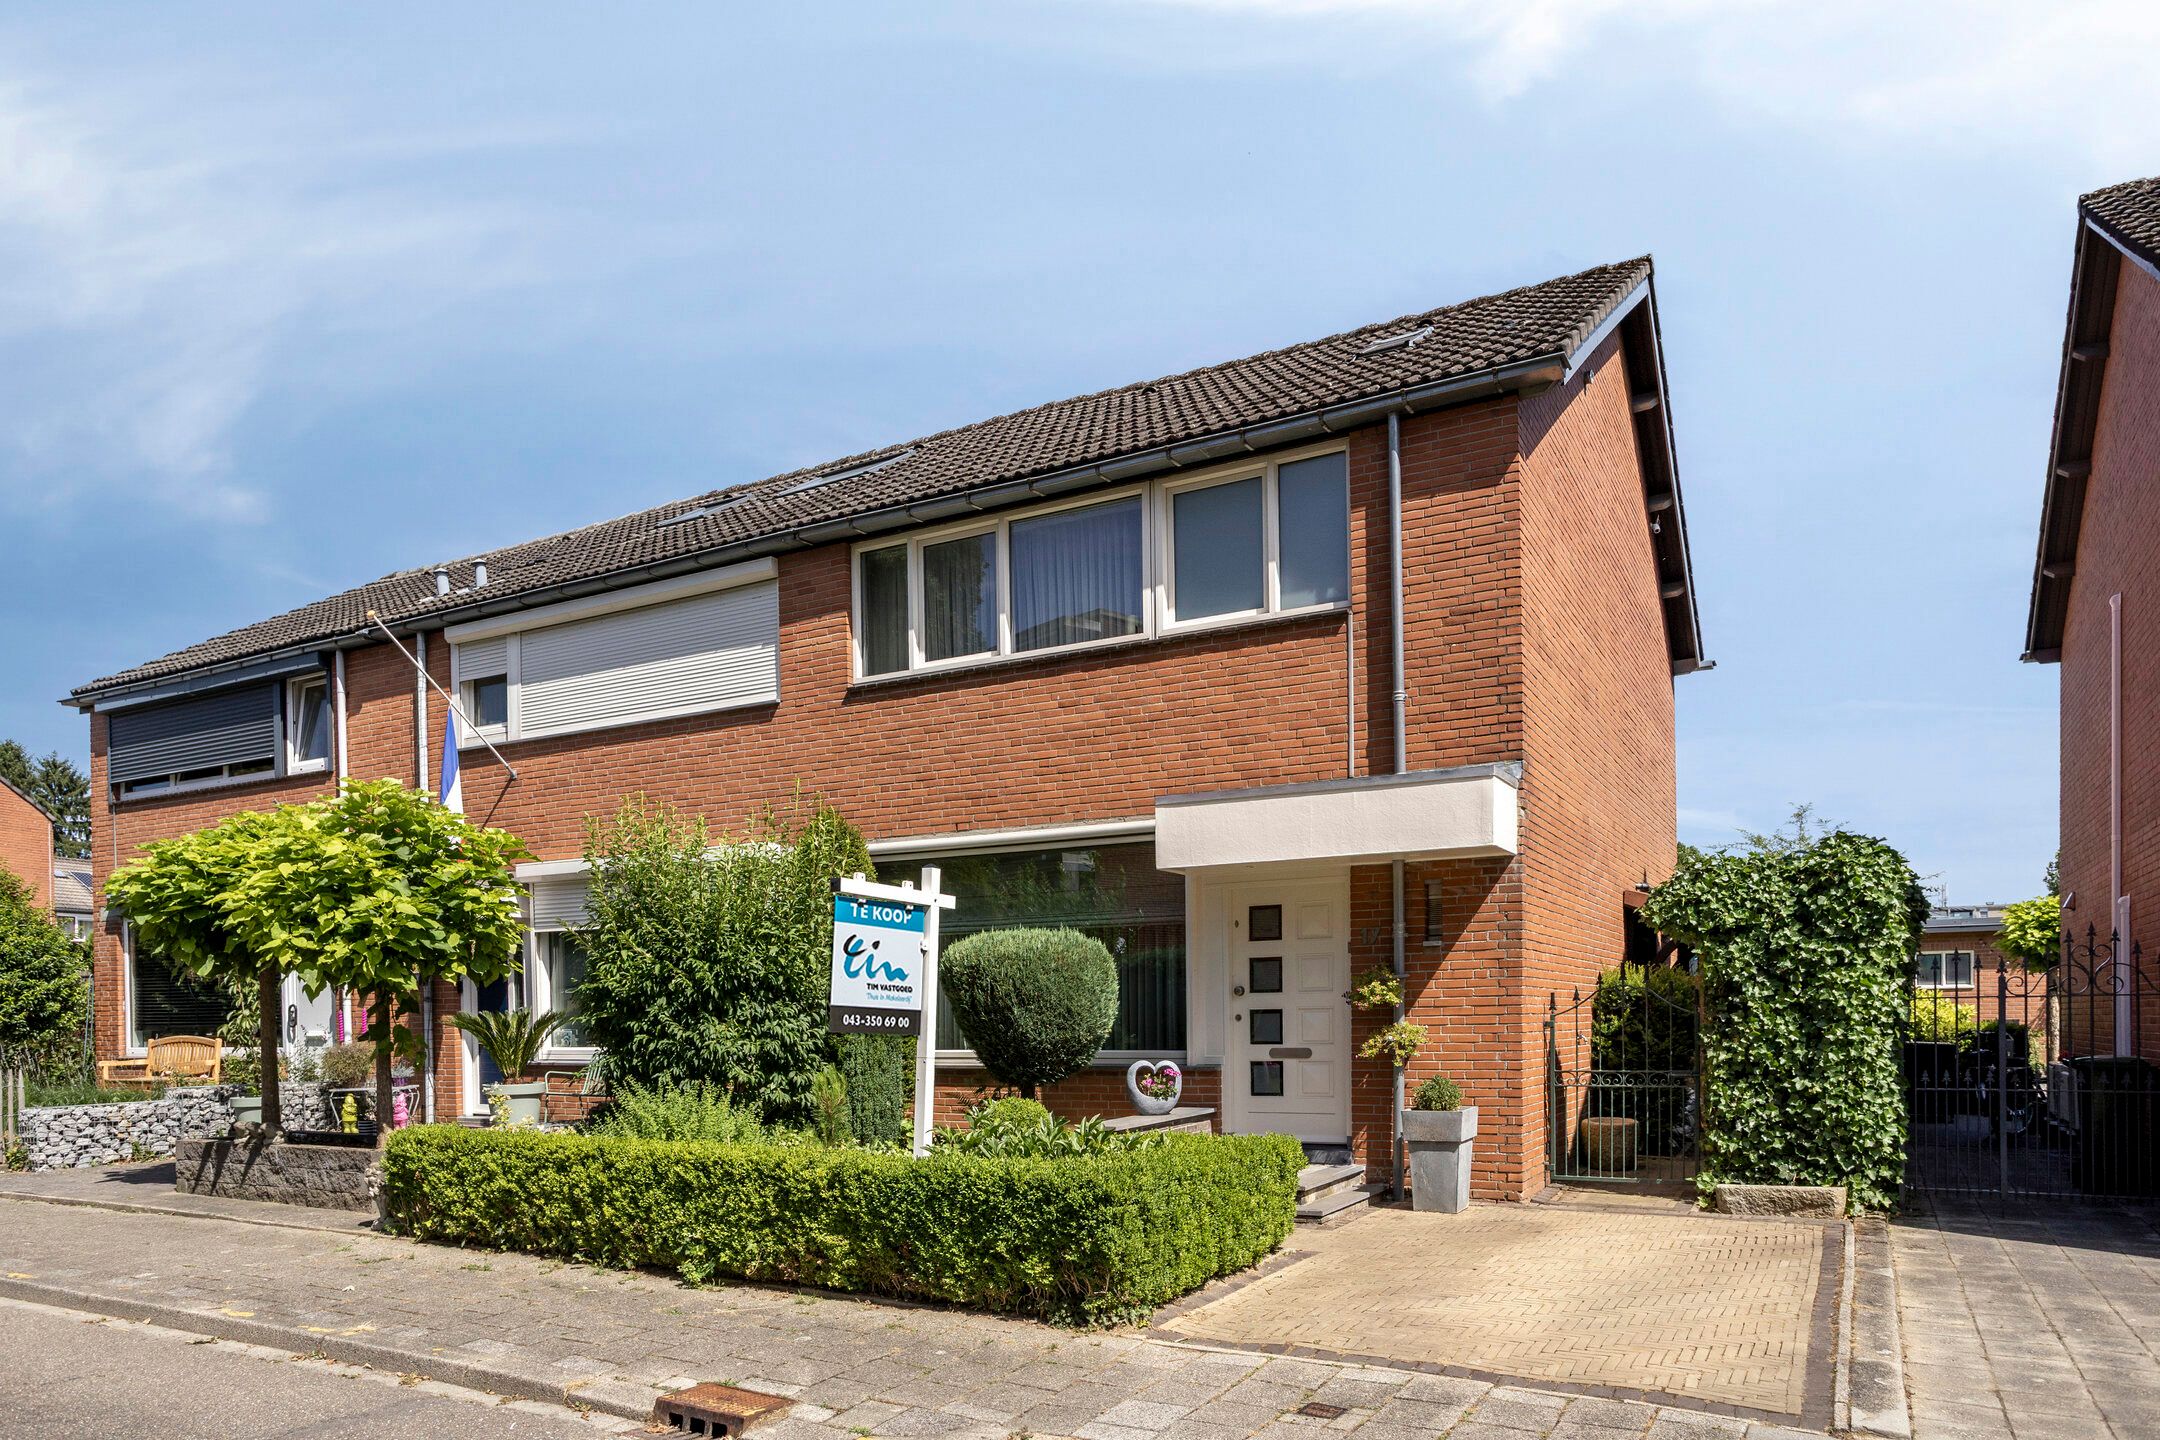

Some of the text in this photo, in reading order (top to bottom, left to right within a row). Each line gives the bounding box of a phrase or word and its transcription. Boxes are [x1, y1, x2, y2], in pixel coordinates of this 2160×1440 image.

[850, 903, 912, 924] TE KOOP
[867, 983, 913, 993] TIM VASTGOED
[843, 1014, 910, 1028] 043-350 69 00
